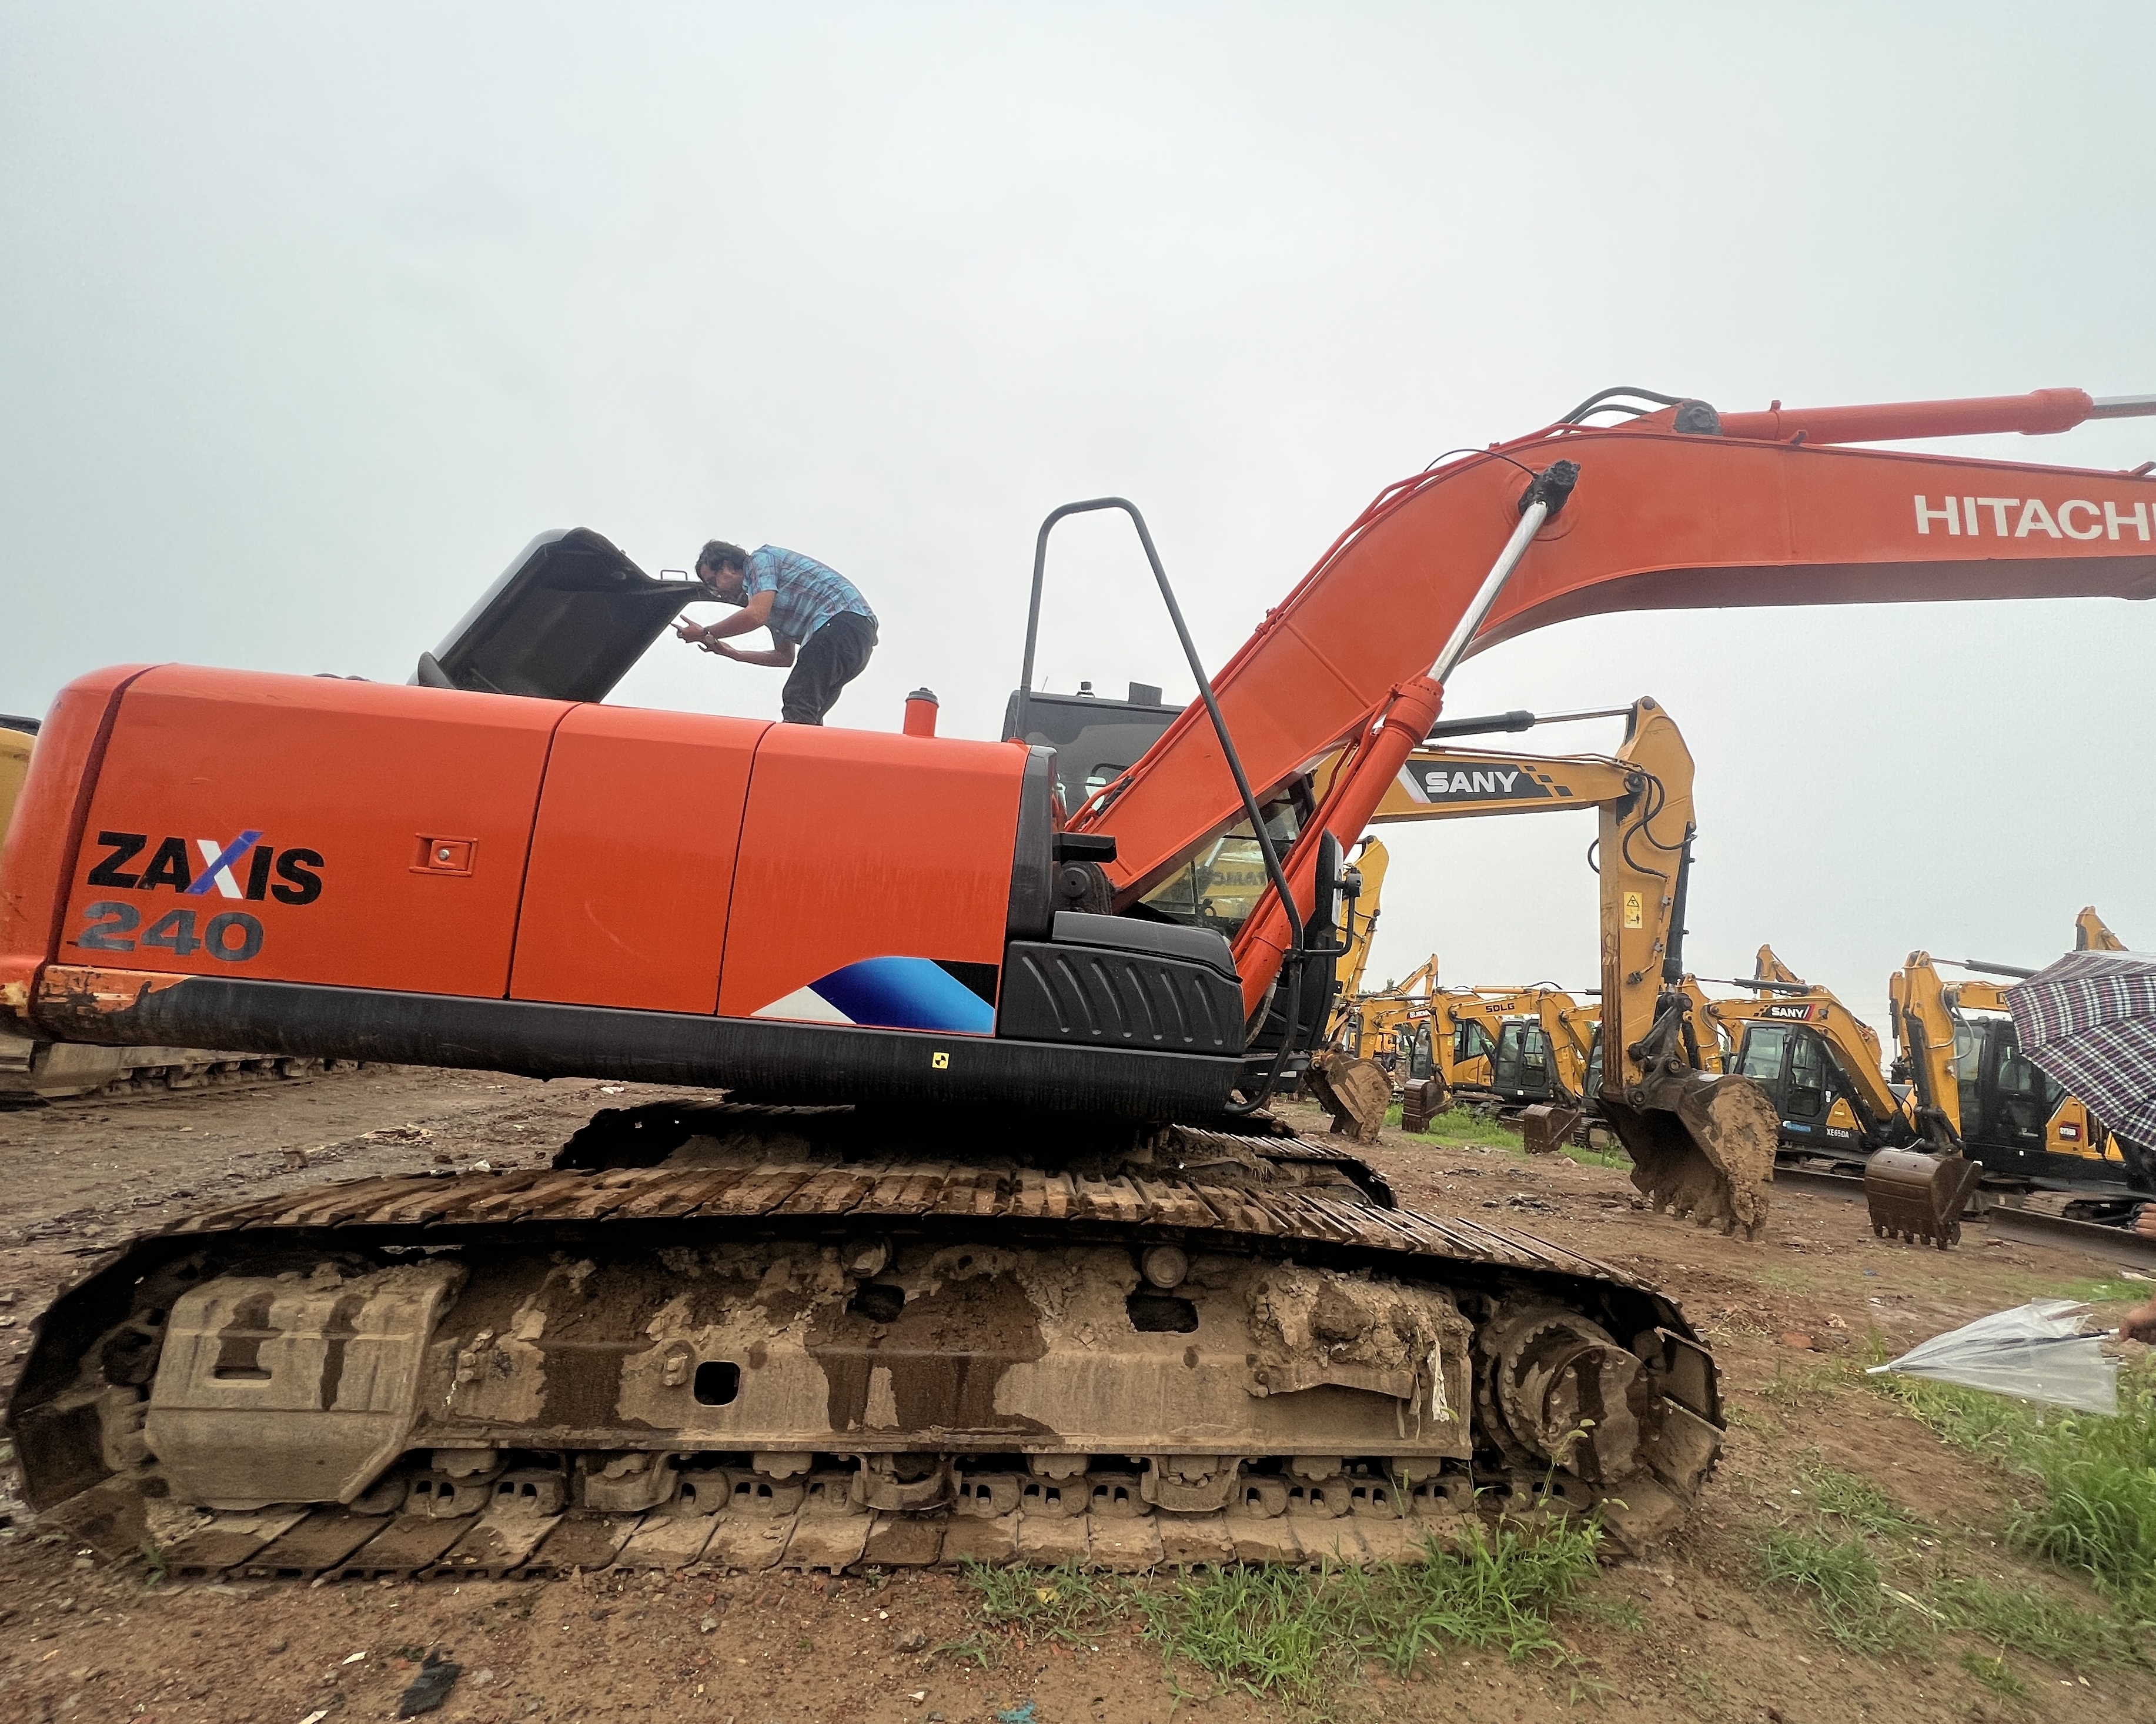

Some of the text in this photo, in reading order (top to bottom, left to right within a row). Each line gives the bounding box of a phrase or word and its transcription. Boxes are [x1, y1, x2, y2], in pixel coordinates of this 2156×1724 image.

[1914, 495, 2156, 541] HITACH
[1425, 771, 1519, 793] SANY
[86, 830, 325, 906] ZAXIS
[77, 901, 264, 961] 240
[1486, 1003, 1515, 1013] SDLG
[1771, 1007, 1804, 1018] SANY
